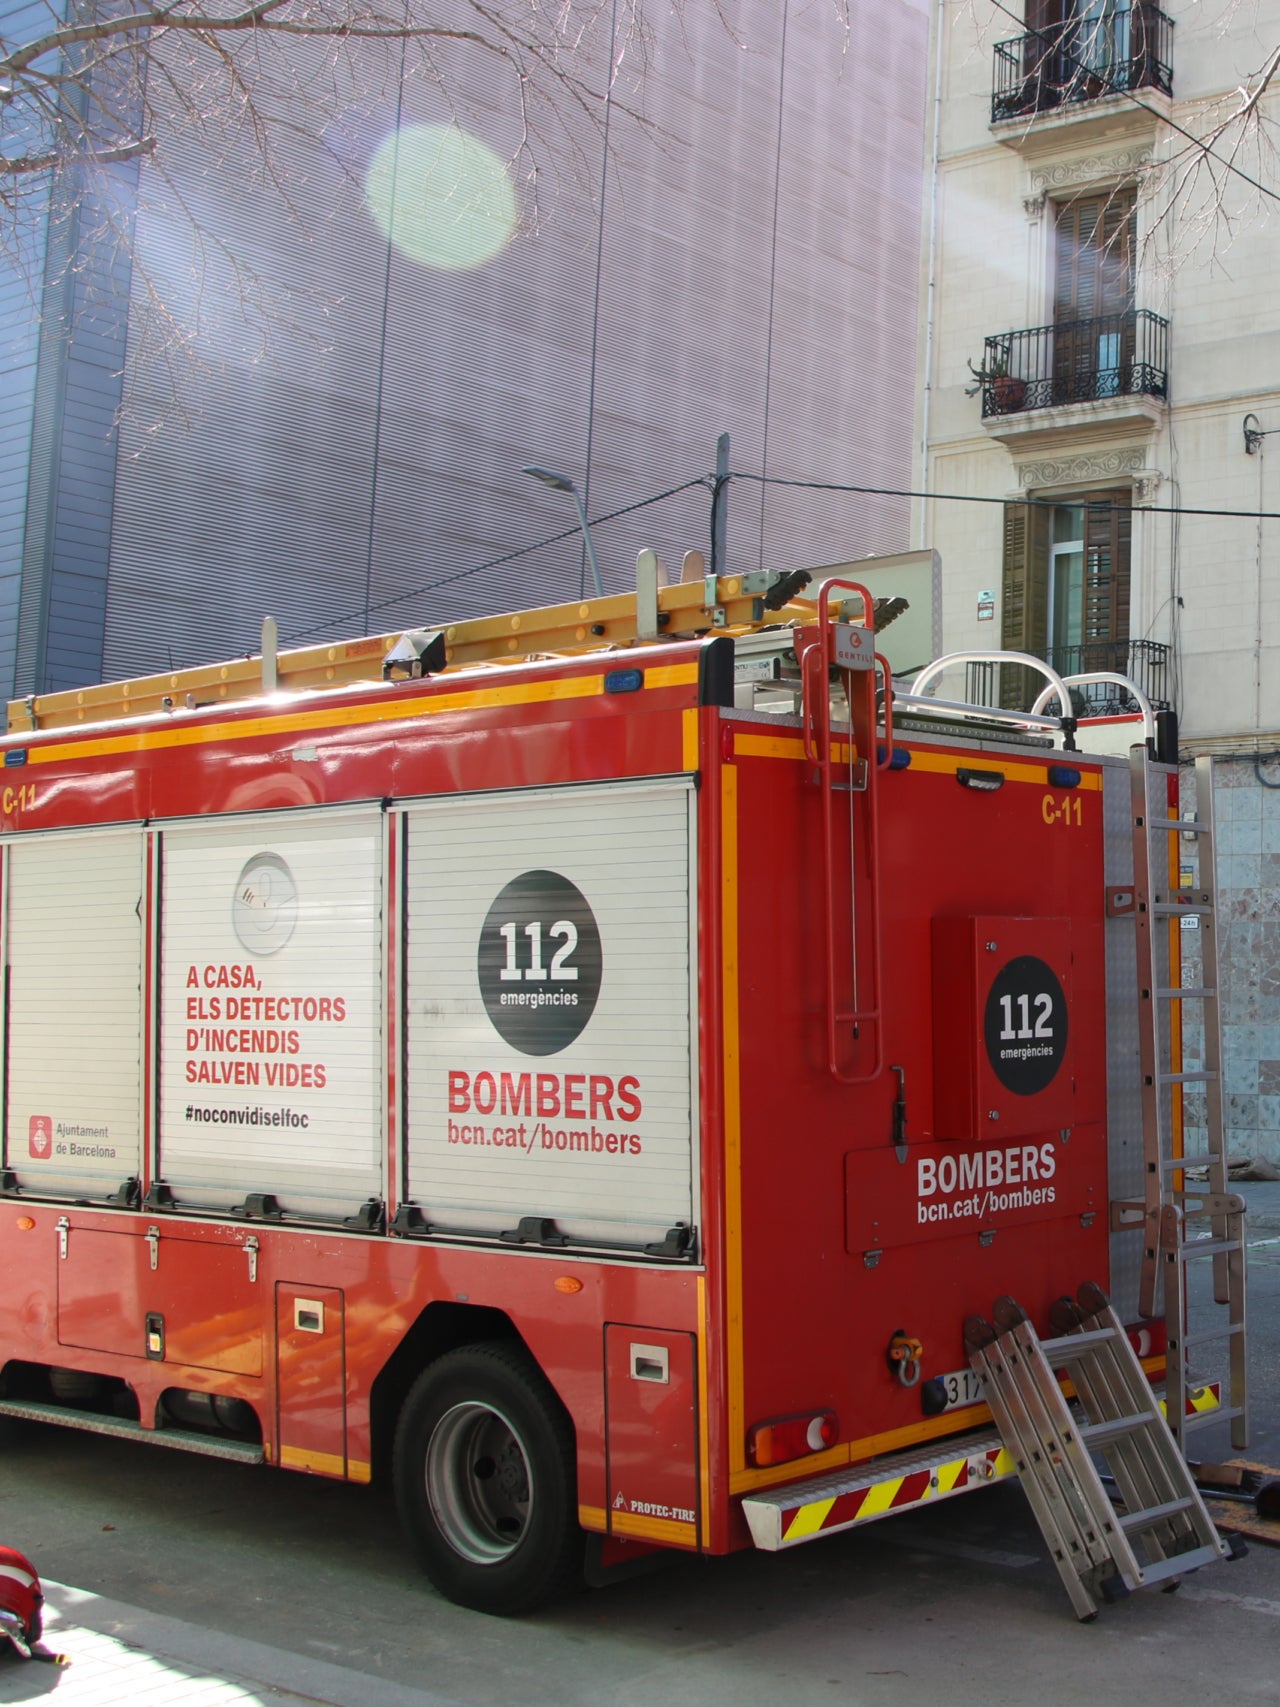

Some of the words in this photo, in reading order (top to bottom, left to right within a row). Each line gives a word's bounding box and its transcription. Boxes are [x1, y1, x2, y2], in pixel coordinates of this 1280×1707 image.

[3, 785, 36, 814] C-11
[1042, 794, 1082, 826] C-11
[500, 920, 578, 980] 112
[186, 966, 199, 988] A
[203, 965, 262, 991] CASA,
[187, 997, 221, 1020] ELS
[226, 997, 346, 1021] DETECTORS
[500, 988, 578, 1009] emergències
[1000, 993, 1053, 1040] 112
[186, 1028, 300, 1054] D'INCENDIS
[1000, 1043, 1053, 1060] emergències
[186, 1060, 259, 1085] SALVEN
[265, 1062, 327, 1088] VIDES
[448, 1070, 642, 1122] BOMBERS
[56, 1123, 109, 1138] Ajuntament
[186, 1105, 309, 1128] #noconvidiselfoc
[56, 1142, 67, 1155] de
[70, 1143, 116, 1158] Barcelona
[448, 1118, 642, 1155] bcn.cat/bombers
[917, 1143, 1056, 1197] BOMBERS
[917, 1186, 1056, 1224] bcn.cat/bombers
[948, 1373, 980, 1404] 317
[630, 1500, 696, 1522] PROTEC-FIRE
